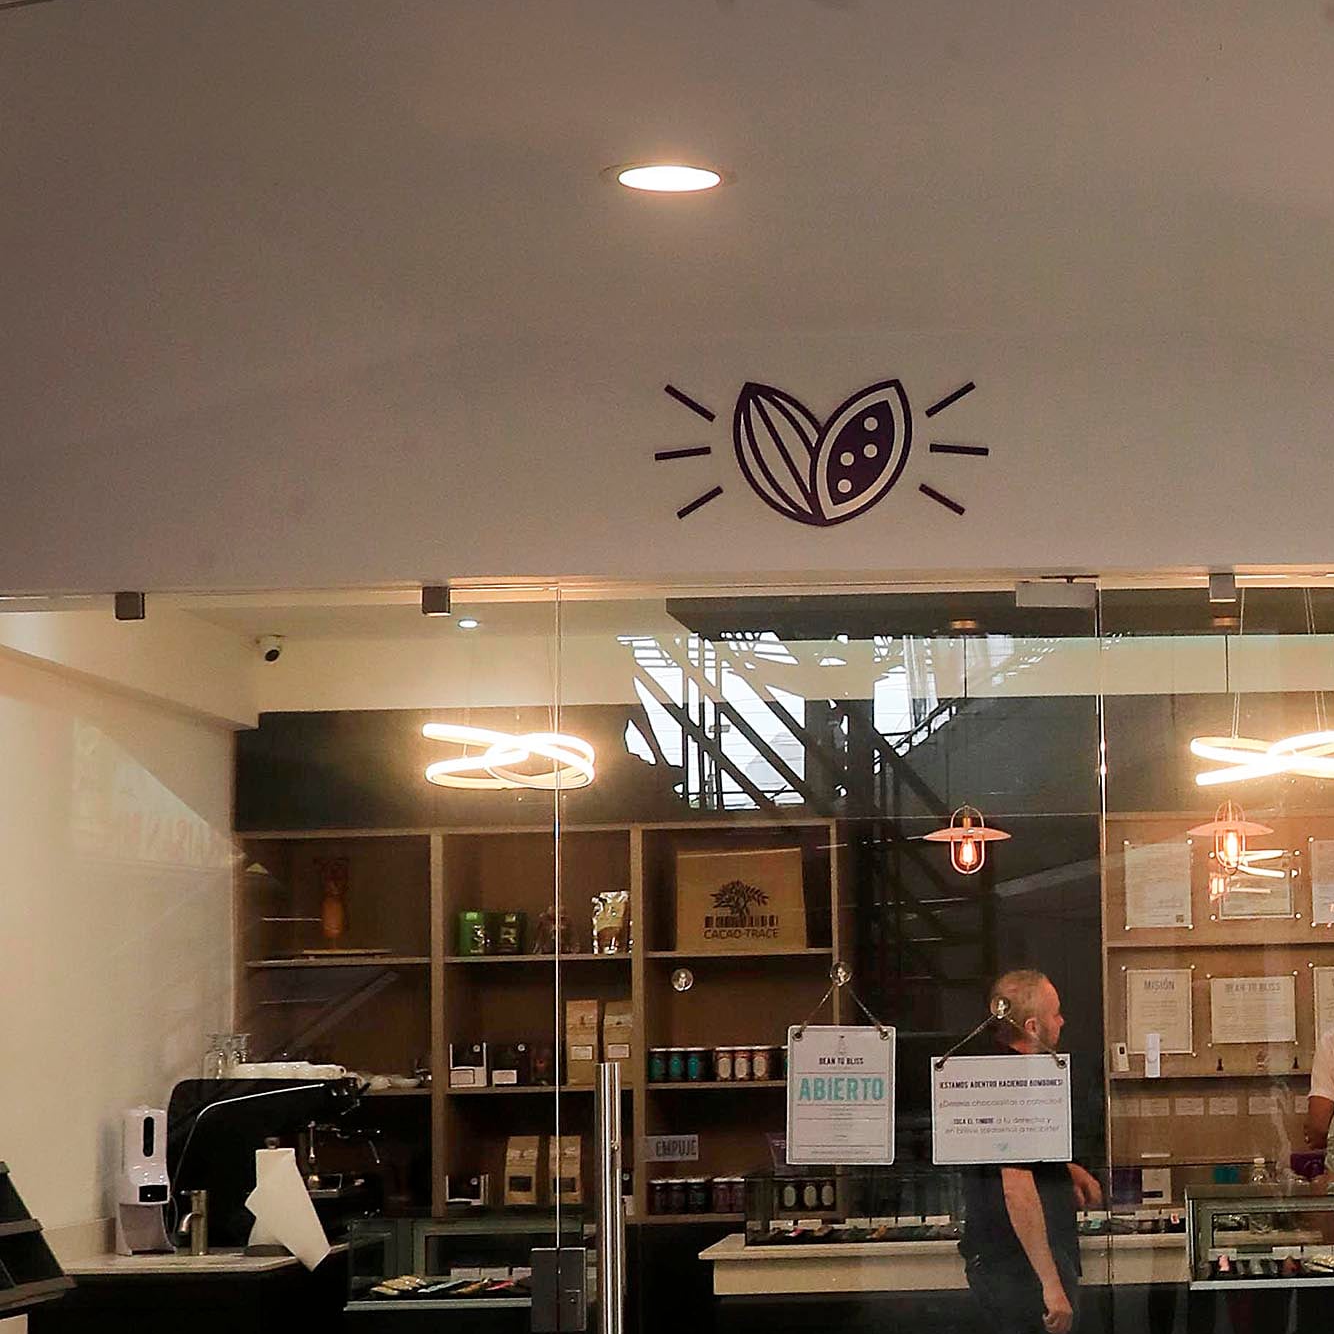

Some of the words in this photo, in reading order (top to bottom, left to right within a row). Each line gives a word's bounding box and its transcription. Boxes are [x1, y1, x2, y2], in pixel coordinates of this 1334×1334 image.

[1144, 977, 1175, 990] MISIÓN
[818, 1057, 836, 1066] BEAN
[837, 1057, 846, 1066] TO
[846, 1057, 865, 1066] BLISS
[799, 1077, 885, 1101] ABIERTO
[655, 1139, 697, 1157] EMPUJE
